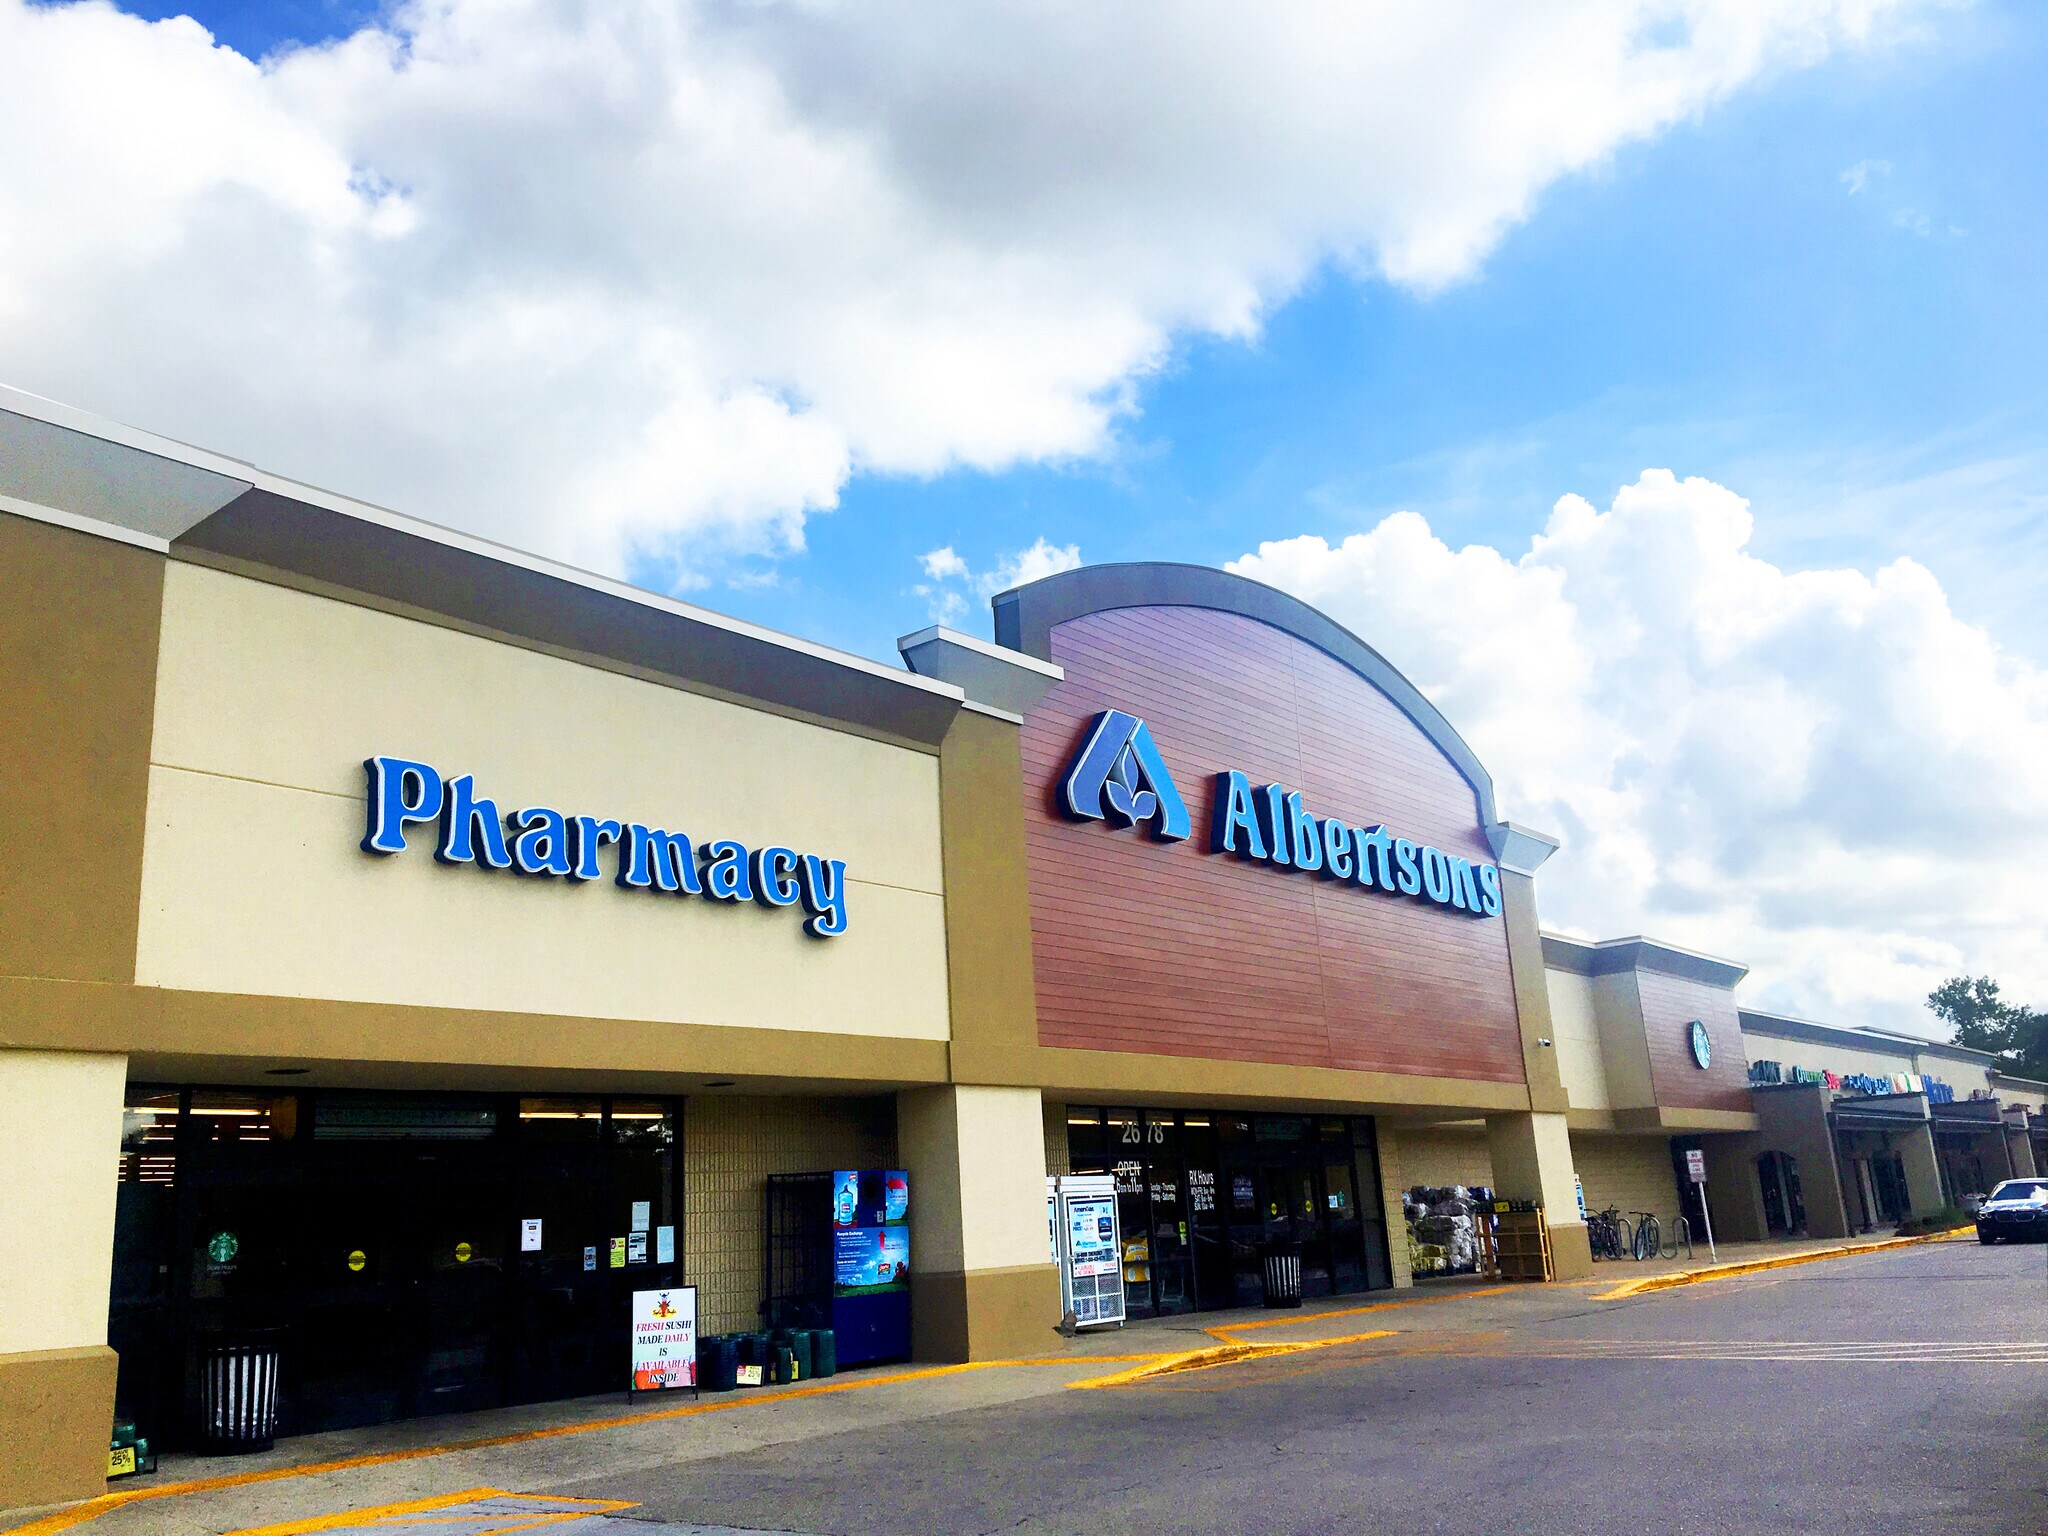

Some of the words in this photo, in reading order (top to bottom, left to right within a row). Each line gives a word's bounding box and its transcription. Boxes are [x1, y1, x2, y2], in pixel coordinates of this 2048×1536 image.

[361, 755, 848, 938] Pharmacy
[1214, 769, 1503, 918] Albertsons
[1117, 1161, 1141, 1177] OPEN
[1198, 1170, 1214, 1185] Hours
[636, 1322, 665, 1332] FRESH
[665, 1320, 692, 1330] SUSHI
[637, 1335, 663, 1345] MADE
[664, 1333, 691, 1343] DAILY
[659, 1347, 668, 1356] IS
[640, 1359, 689, 1371] AVAILABLE
[648, 1372, 680, 1384] INSIDE
[111, 1454, 131, 1466] 25%
